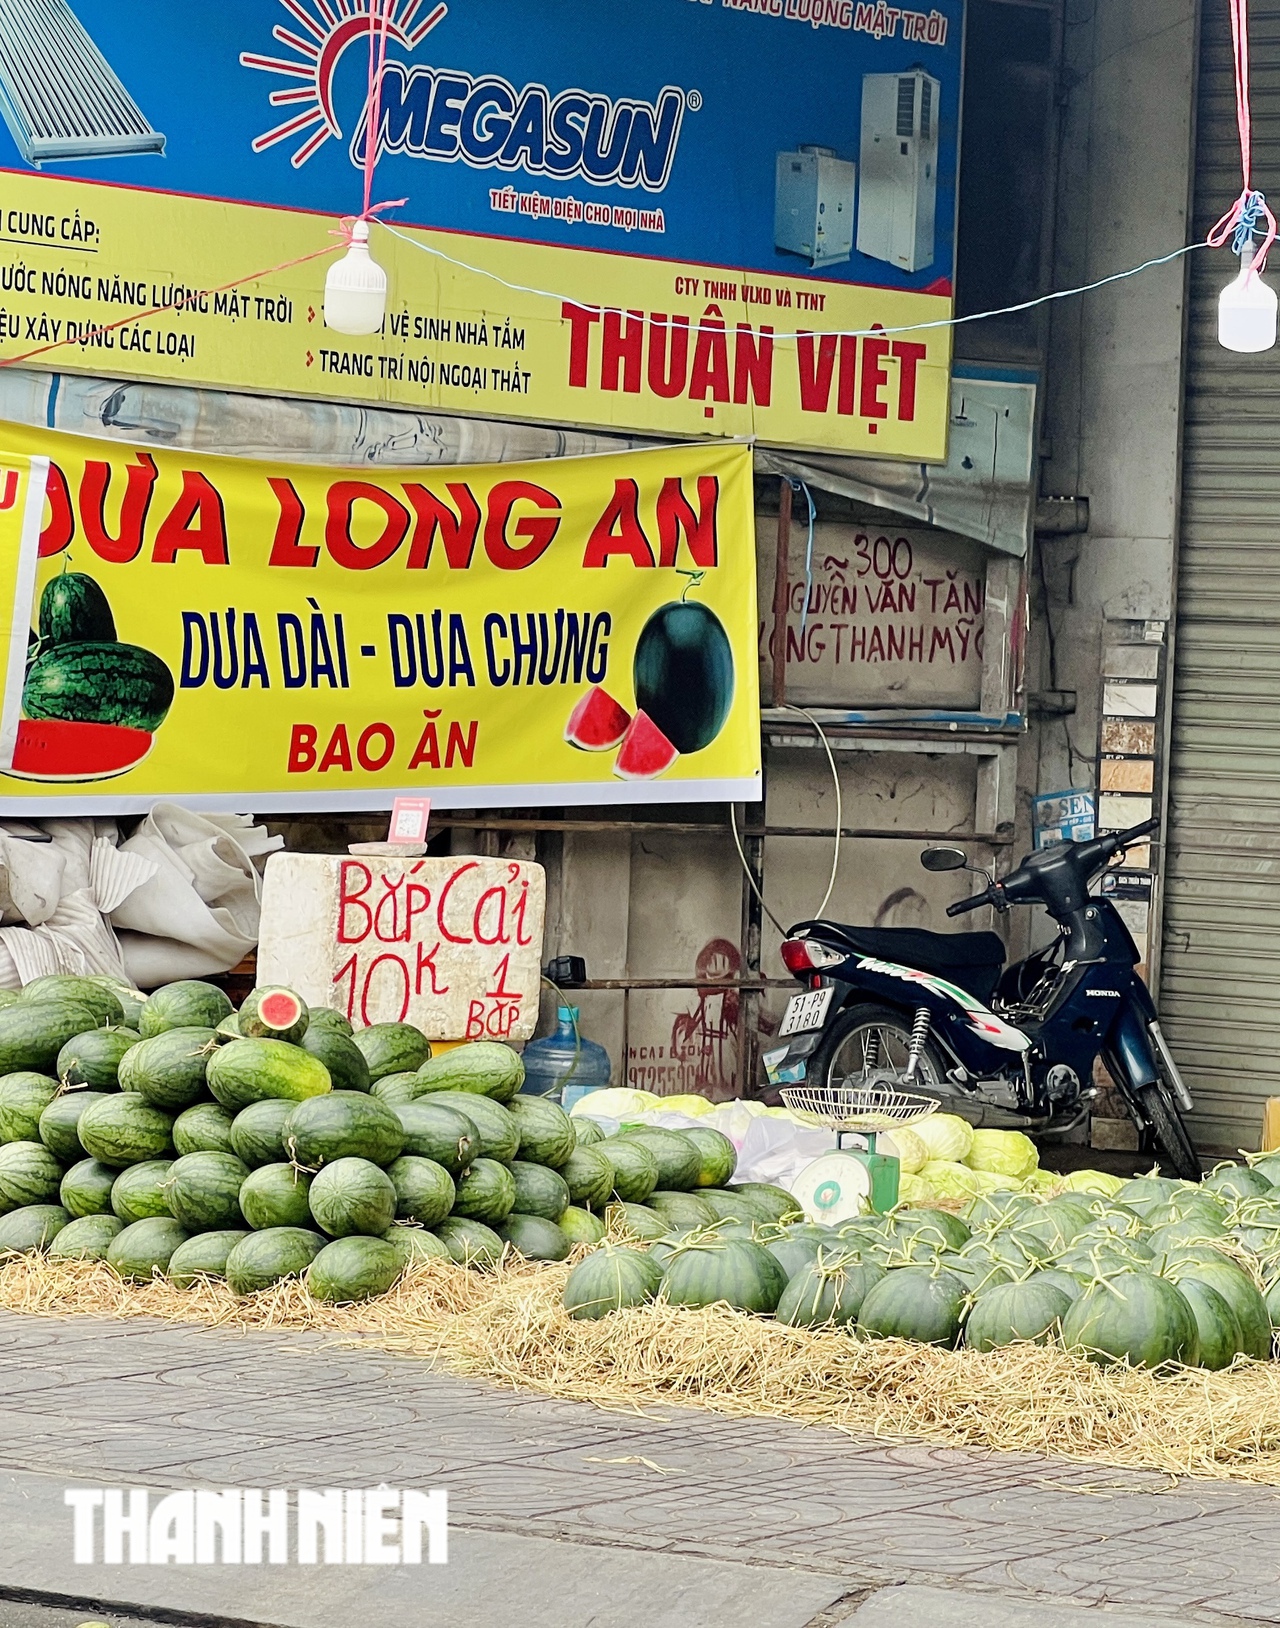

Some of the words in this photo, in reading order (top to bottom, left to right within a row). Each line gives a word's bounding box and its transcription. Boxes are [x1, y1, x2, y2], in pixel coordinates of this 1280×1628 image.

[855, 1, 900, 39] MẶT
[903, 11, 947, 45] TRỜI
[350, 60, 685, 192] MEGASUN
[8, 210, 55, 238] CUNG
[61, 209, 100, 244] CẤP:
[490, 186, 517, 211] TIẾT
[520, 192, 550, 218] KIỆM
[553, 197, 582, 223] ĐIỆN
[585, 204, 610, 224] CHO
[613, 208, 637, 231] MỌI
[640, 209, 665, 232] NHÀ
[42, 267, 92, 300] NÓNG
[97, 274, 147, 306] NĂNG
[152, 284, 208, 317] LƯỢNG
[214, 288, 251, 324] MẶT
[254, 294, 293, 324] TRỜI
[675, 276, 699, 296] CTY
[703, 280, 737, 301] TNHH
[741, 284, 772, 305] VLXD
[776, 287, 792, 307] VÀ
[796, 291, 826, 311] TTNT
[25, 312, 62, 343] XÂY
[66, 319, 115, 352] DỰNG
[119, 323, 151, 353] CÁC
[156, 331, 195, 363] LOẠI
[390, 310, 410, 343] VỆ
[413, 317, 451, 342] SINH
[455, 318, 488, 347] NHÀ
[493, 317, 525, 351] TẮM
[319, 349, 373, 377] TRANG
[378, 353, 404, 381] TRÍ
[408, 355, 435, 389] NỘI
[439, 363, 487, 395] NGOẠI
[491, 360, 532, 394] THẤT
[560, 300, 774, 419] THUẬN
[796, 323, 926, 434] VIỆT
[37, 452, 230, 566] DƯA
[267, 477, 562, 571] LONG
[582, 475, 720, 569] AN
[854, 534, 913, 580] 300
[773, 556, 857, 615] GUYỄN
[865, 579, 916, 614] VĂN
[180, 606, 269, 690] DƯA
[277, 597, 349, 689] DÀI
[390, 606, 476, 688] DƯA
[486, 606, 612, 687] CHƯNG
[829, 623, 924, 665] THẠNH
[929, 617, 974, 664] MỸ
[286, 723, 395, 774] BAO
[407, 709, 479, 770] ĂN
[485, 952, 524, 999] 1
[1085, 989, 1121, 998] HONDA
[786, 1010, 820, 1033] 3180
[792, 991, 827, 1014] 51-P9
